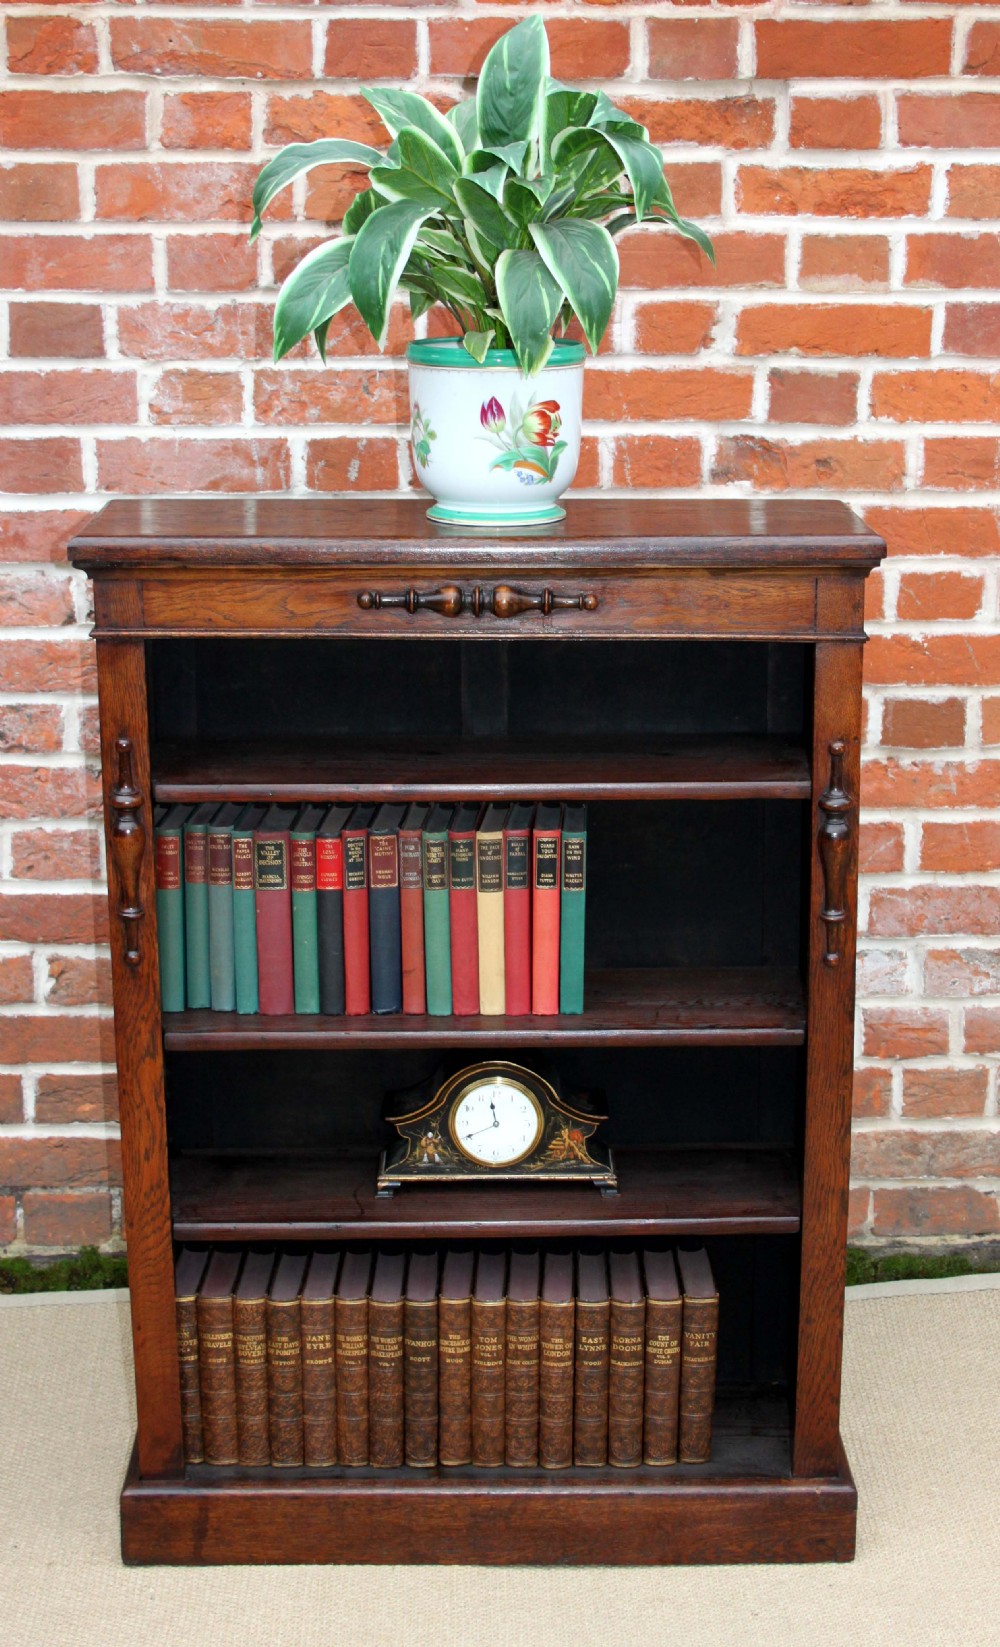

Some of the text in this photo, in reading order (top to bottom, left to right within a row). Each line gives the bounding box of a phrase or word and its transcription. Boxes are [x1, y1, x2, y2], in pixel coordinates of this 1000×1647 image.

[685, 1332, 716, 1340] VANITY
[405, 1339, 437, 1347] IVANHOE
[541, 1342, 564, 1350] TOWER
[579, 1344, 606, 1352] LYNNE
[613, 1344, 642, 1352] DOONE
